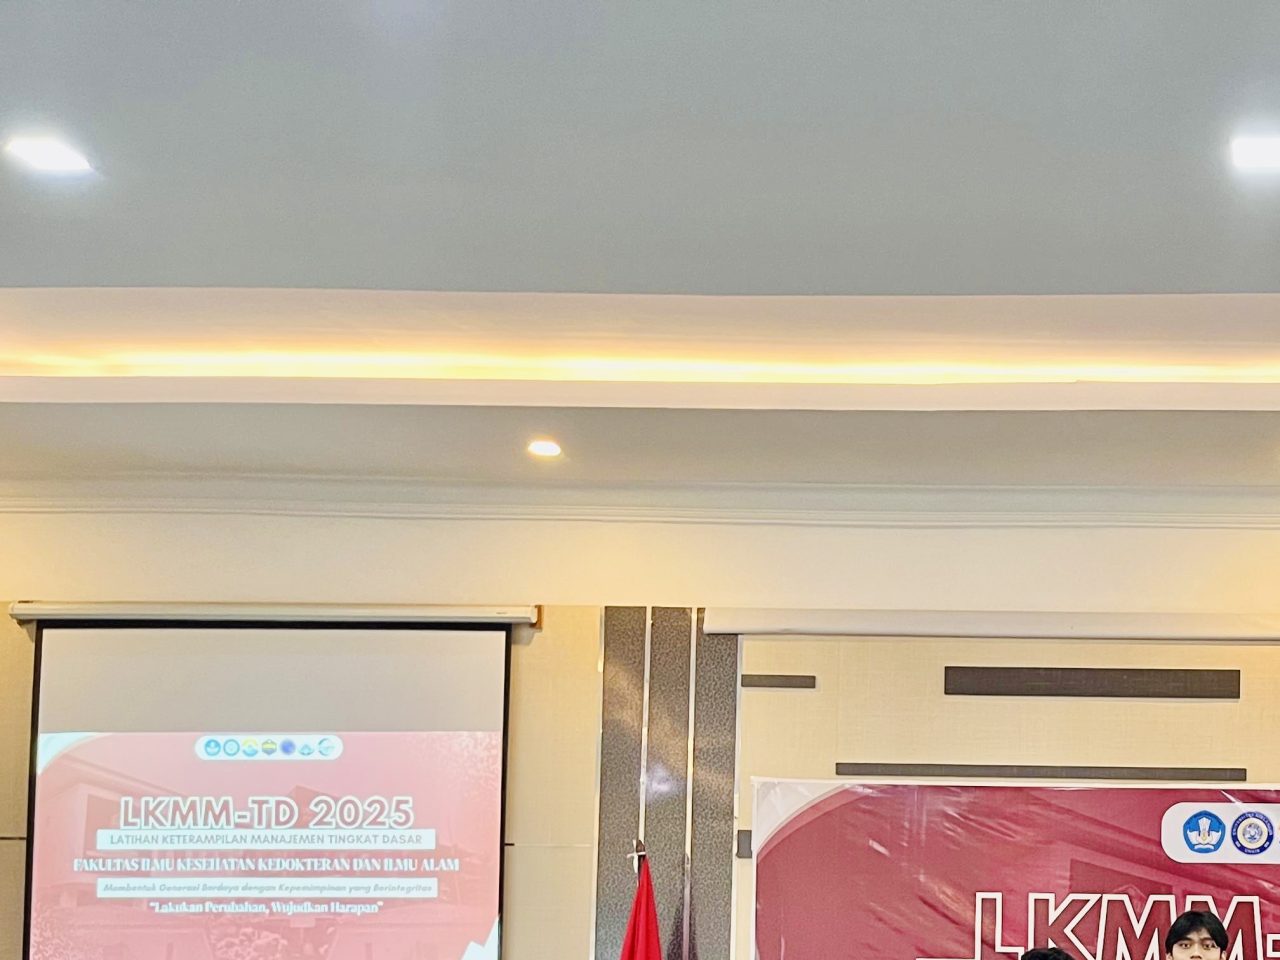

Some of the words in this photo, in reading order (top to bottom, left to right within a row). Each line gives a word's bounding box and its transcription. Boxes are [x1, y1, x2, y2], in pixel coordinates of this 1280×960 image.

[119, 796, 298, 829] LKMM-TD
[308, 795, 414, 829] 2025
[110, 834, 158, 845] LATIHAN
[162, 834, 247, 845] KETERAMPILAN
[251, 834, 324, 845] MANAJEMEN
[328, 834, 379, 845] TINGKAT
[382, 834, 422, 845] DASAR
[73, 858, 139, 871] FAKULTAS
[141, 858, 174, 871] ILMU
[177, 858, 255, 871] KESEHATAN
[258, 858, 350, 871] KEDOKTERAN
[353, 858, 381, 871] DAN
[384, 858, 417, 871] ILMU
[421, 858, 460, 871] ALAM
[103, 883, 157, 891] Membentuk
[159, 883, 200, 891] Generasi
[241, 883, 276, 893] dengan
[349, 885, 370, 893] yang
[271, 902, 328, 915] Wujudkan
